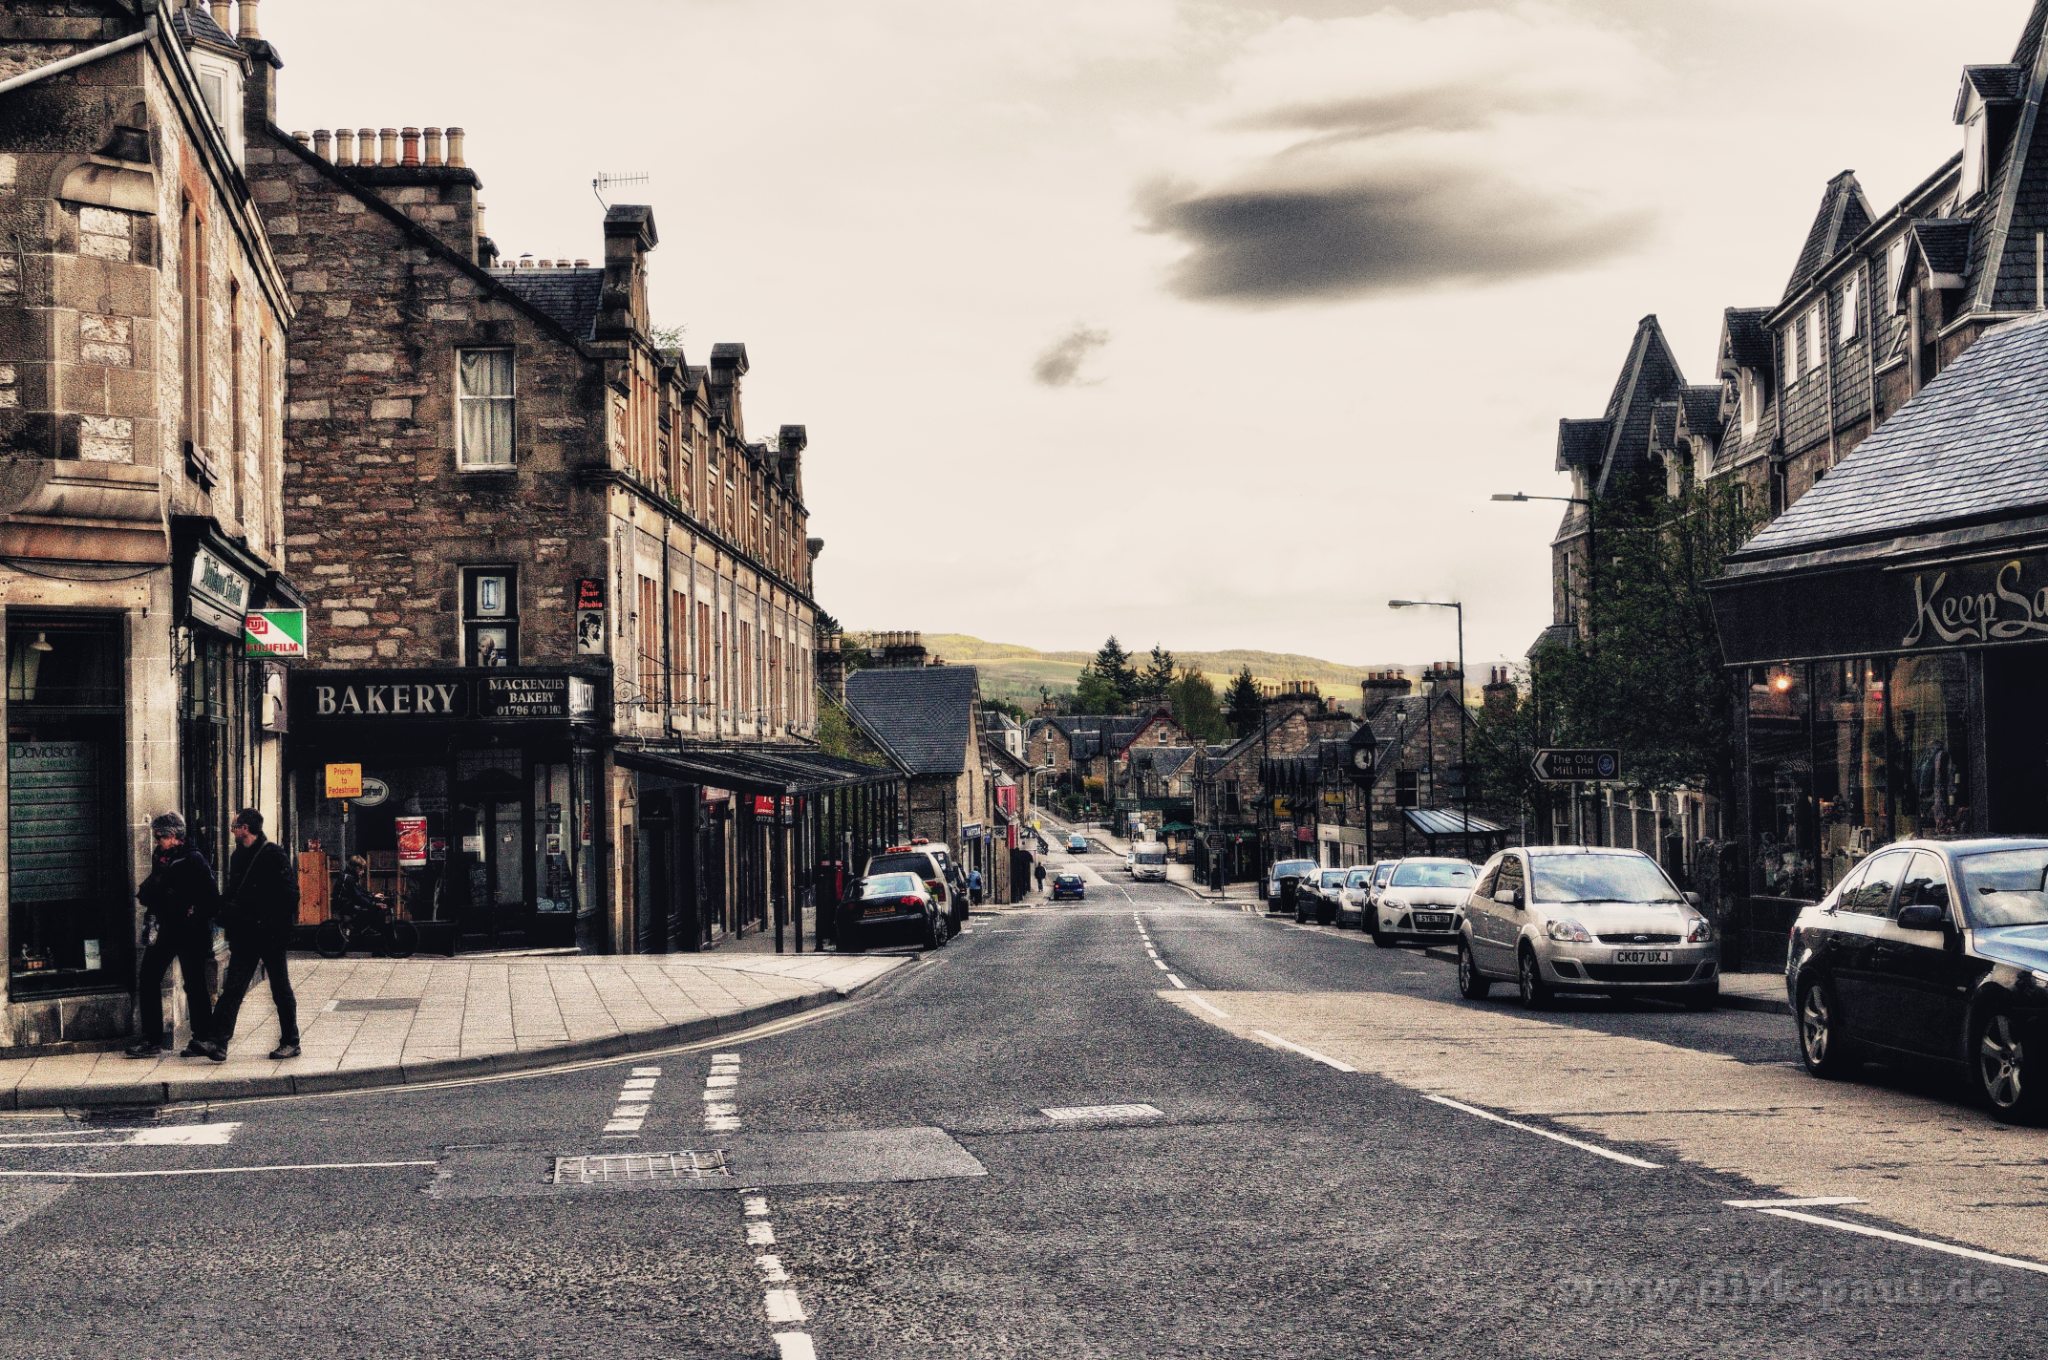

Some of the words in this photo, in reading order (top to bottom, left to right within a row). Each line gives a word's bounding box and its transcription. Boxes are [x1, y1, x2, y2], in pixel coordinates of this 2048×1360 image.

[580, 588, 599, 597] Hair
[577, 597, 603, 610] Studio
[247, 643, 298, 652] FUJIFILM
[316, 684, 459, 715] BAKERY
[509, 692, 554, 703] BAKERY
[497, 705, 529, 716] 01796
[531, 705, 547, 715] 470
[549, 705, 561, 715] 102
[1552, 755, 1571, 764] The
[1574, 755, 1594, 764] Old
[333, 767, 354, 777] Priority
[1553, 766, 1573, 775] Mill
[1577, 766, 1594, 775] Inn
[328, 786, 360, 795] Pedestrians
[1617, 951, 1645, 963] CK07
[1648, 951, 1669, 963] UXJ
